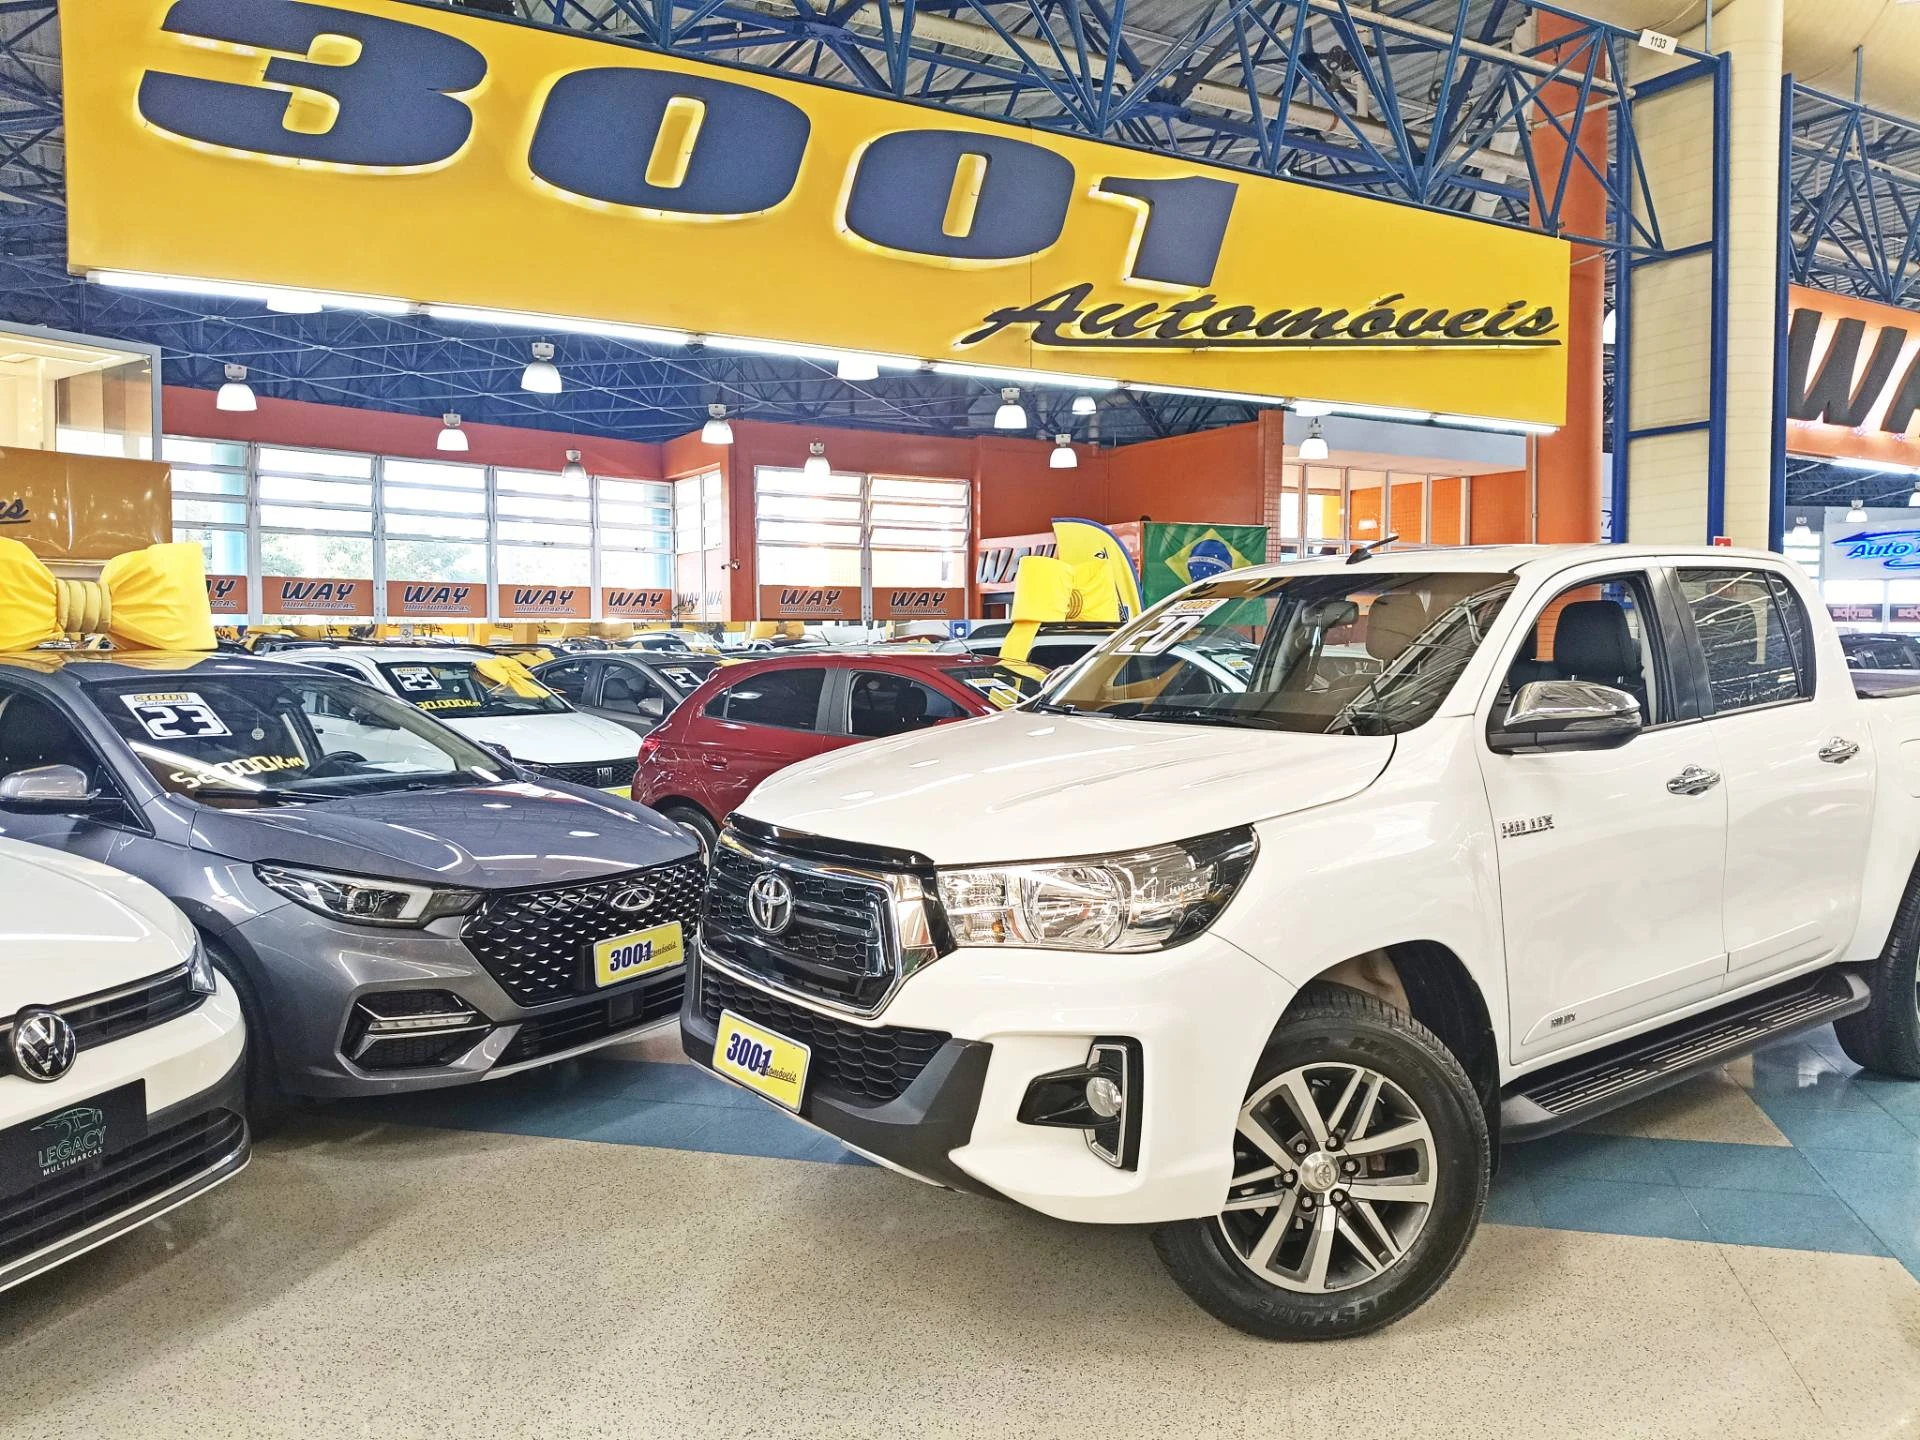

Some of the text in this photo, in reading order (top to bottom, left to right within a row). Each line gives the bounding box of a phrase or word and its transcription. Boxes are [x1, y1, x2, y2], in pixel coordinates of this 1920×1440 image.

[1650, 36, 1666, 48] 1133
[138, 0, 1239, 290] 3001
[957, 283, 1561, 346] Automóveis
[1846, 542, 1910, 556] Auto
[281, 581, 355, 600] WAY
[403, 586, 470, 603] WAY
[513, 589, 574, 605] WAY
[608, 591, 663, 606] WAY
[780, 589, 841, 605] WAY
[890, 591, 946, 606] WAY
[1117, 615, 1201, 652] 20
[399, 674, 439, 689] 25
[139, 706, 225, 735] 23
[1500, 814, 1554, 838] HILUX
[609, 940, 652, 972] 3001
[726, 1032, 772, 1077] 3001
[38, 1125, 107, 1168] LEGACY
[43, 1146, 103, 1177] MULTIMARCAS
